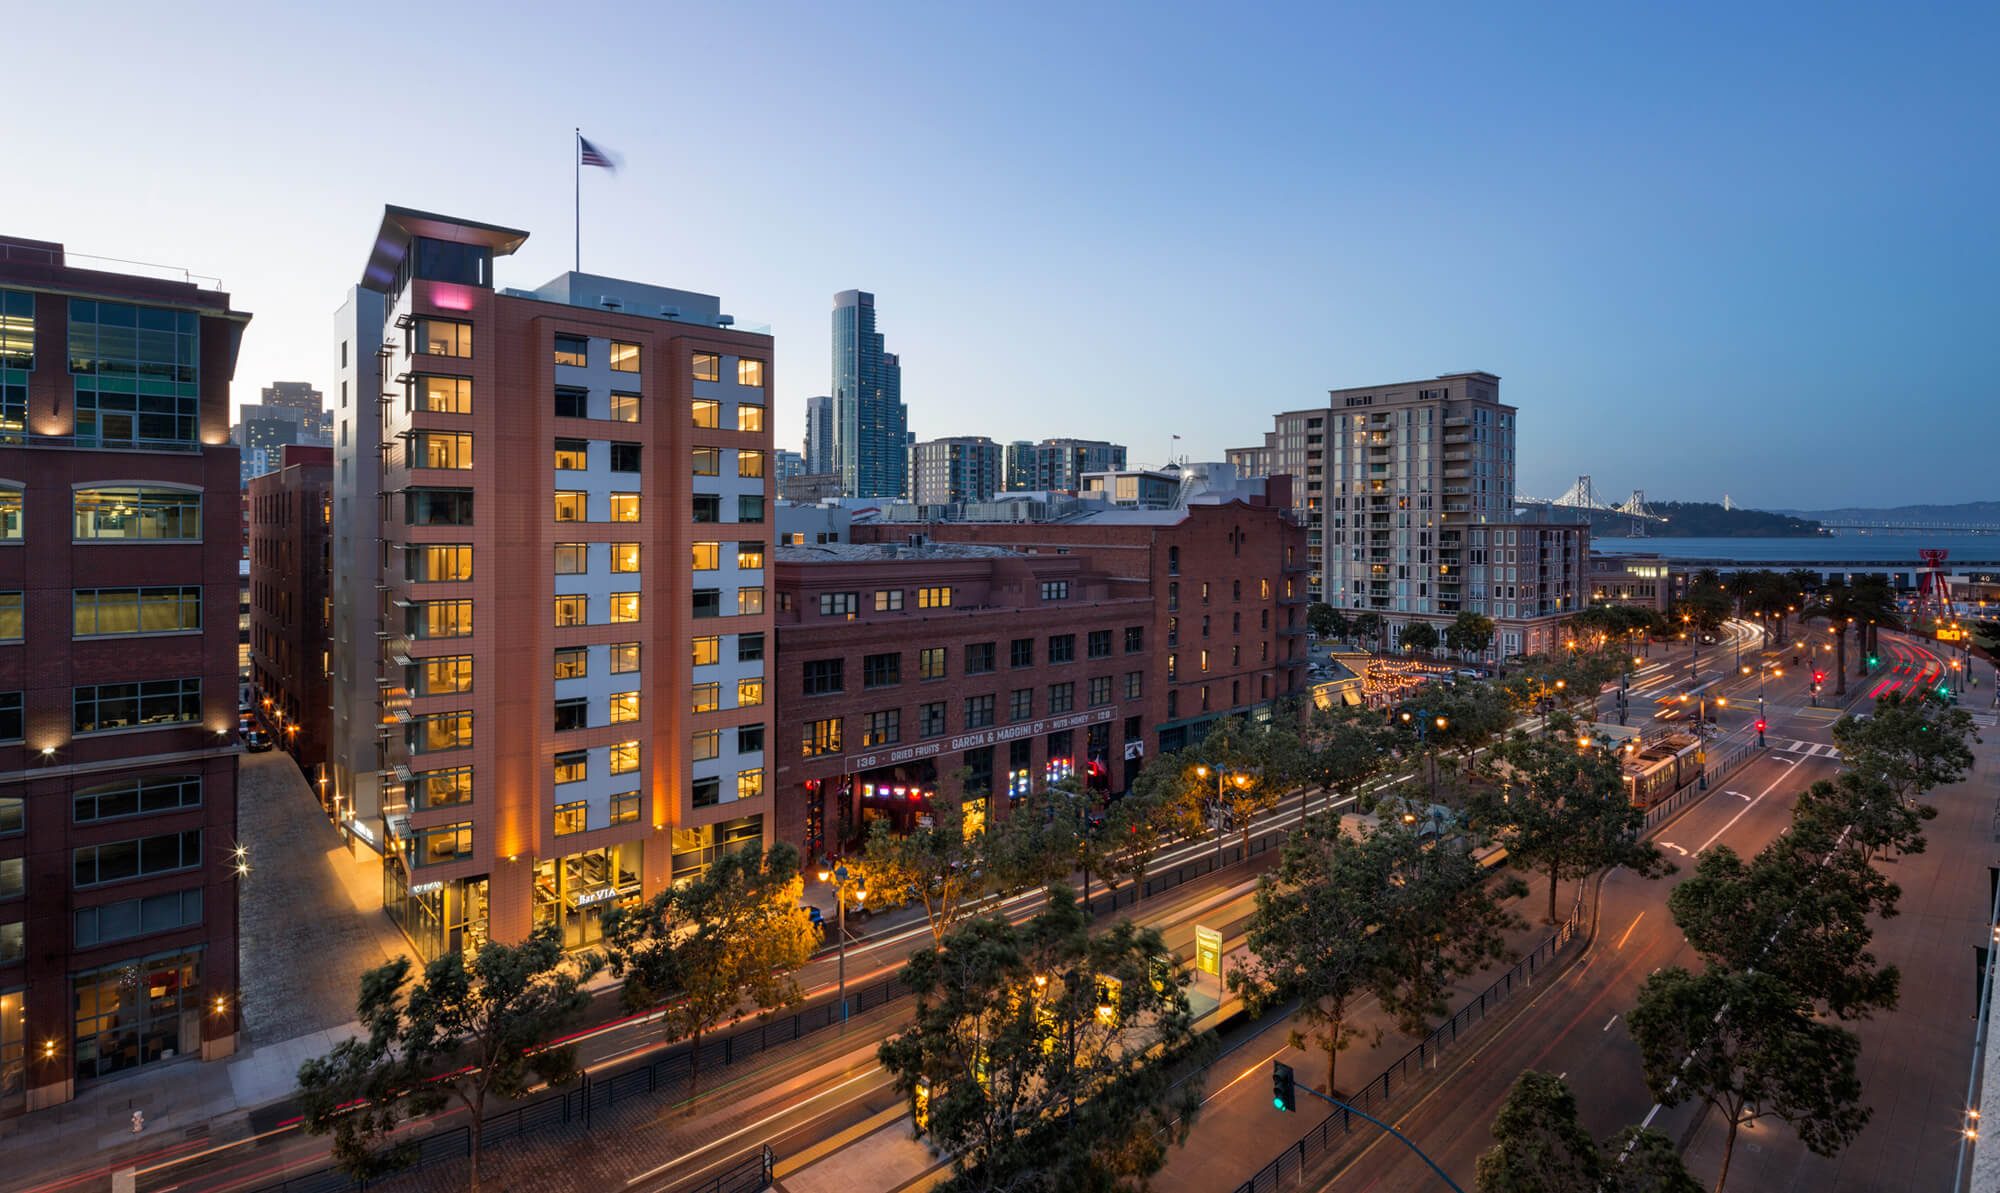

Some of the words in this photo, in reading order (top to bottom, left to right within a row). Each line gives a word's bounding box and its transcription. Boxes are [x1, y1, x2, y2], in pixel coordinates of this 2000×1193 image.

[856, 756, 877, 768] 136
[891, 748, 914, 761] DRIED
[915, 743, 940, 757] FRUITS
[952, 734, 984, 750] GARCIA
[987, 732, 994, 743] &
[997, 725, 1031, 741] MAGGINI
[596, 887, 616, 900] VIA
